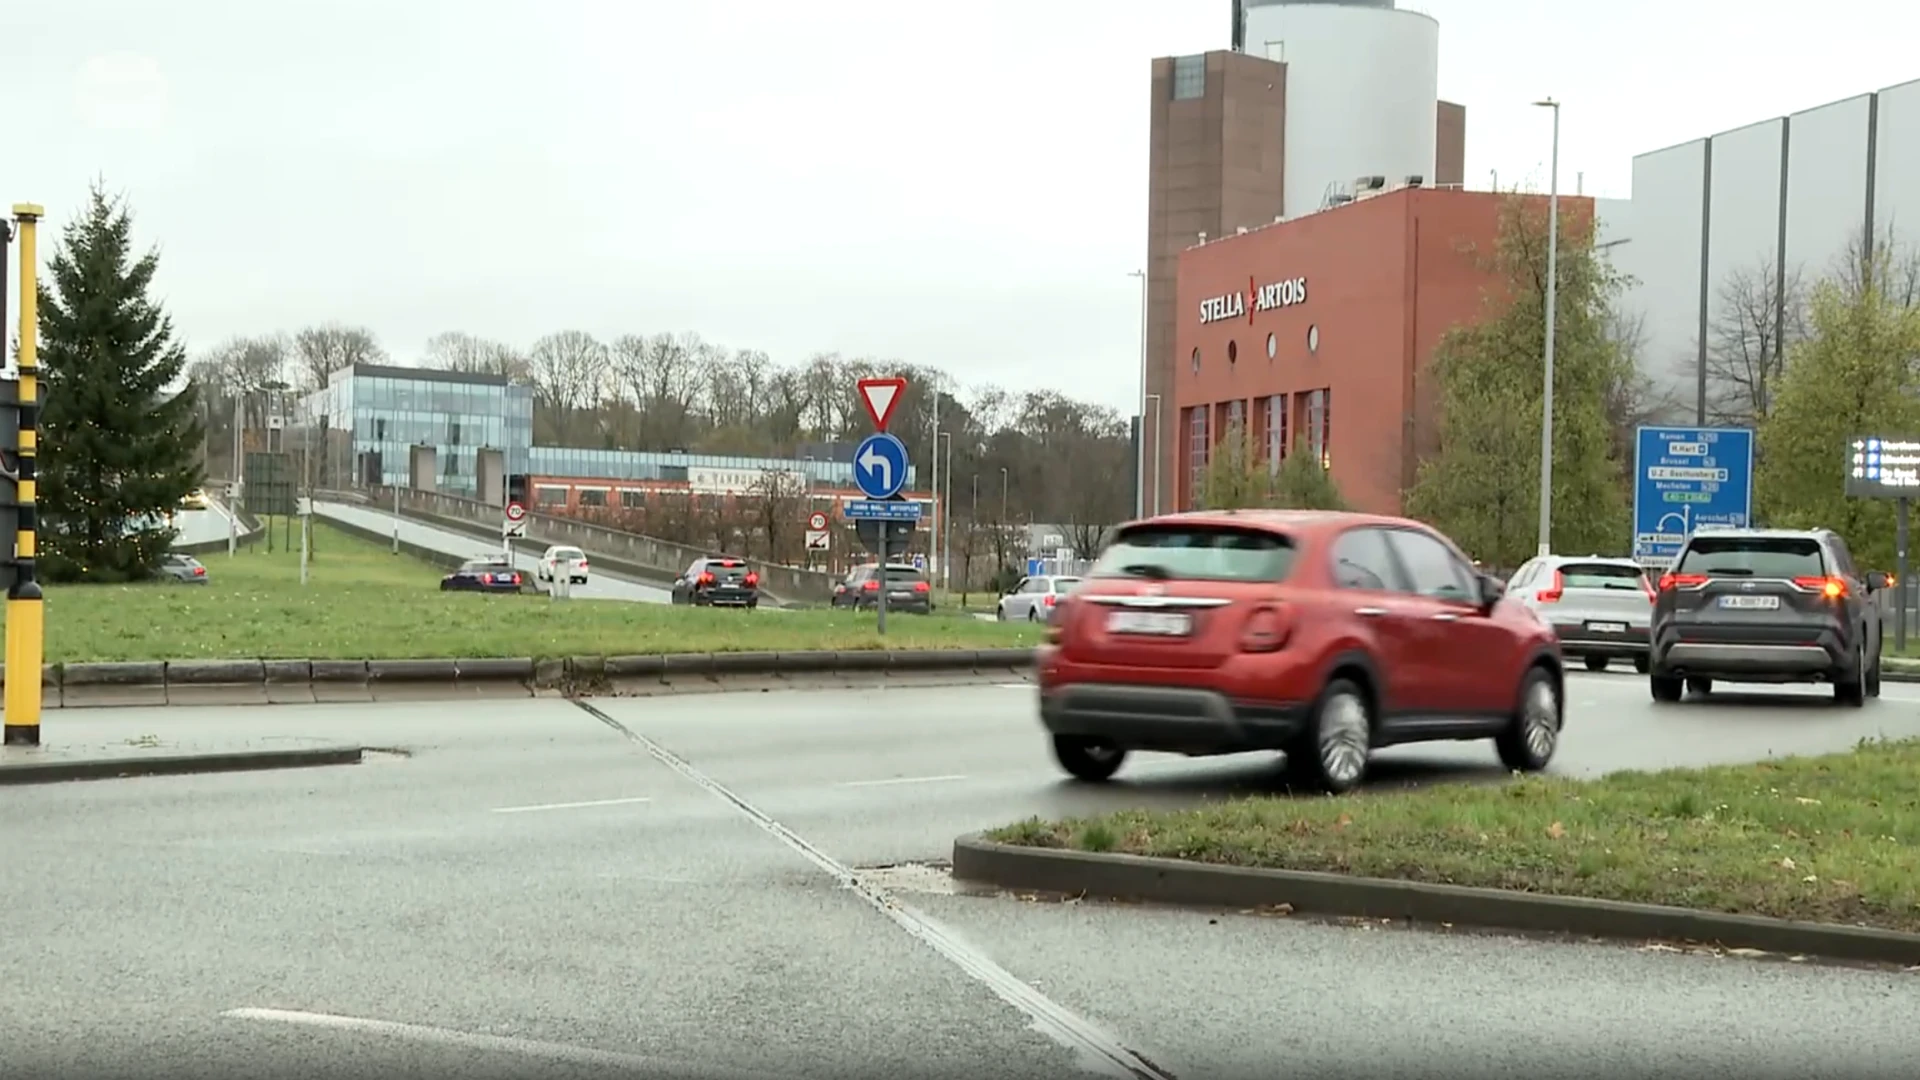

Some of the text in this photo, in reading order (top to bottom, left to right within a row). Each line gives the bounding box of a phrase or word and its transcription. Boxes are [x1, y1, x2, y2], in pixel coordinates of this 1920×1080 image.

[1200, 277, 1306, 324] STELLA ARTOIS
[511, 507, 521, 515] 70
[814, 517, 824, 526] 70
